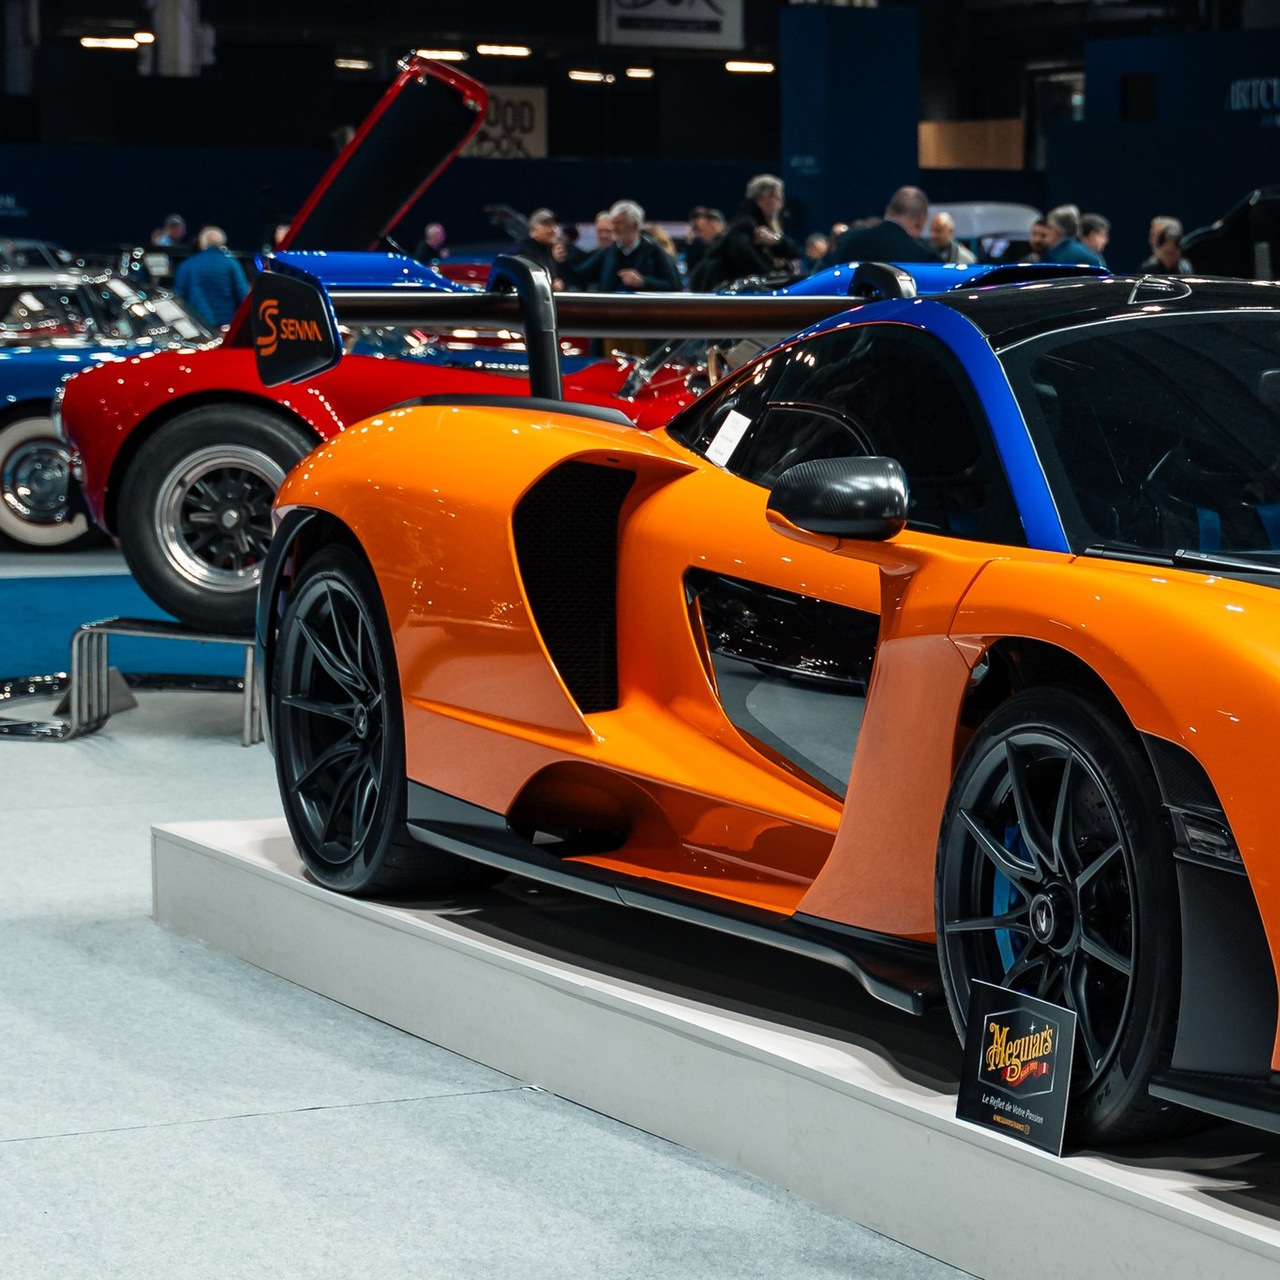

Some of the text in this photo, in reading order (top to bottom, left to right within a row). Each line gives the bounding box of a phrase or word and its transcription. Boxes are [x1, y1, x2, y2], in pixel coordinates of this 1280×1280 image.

[280, 319, 322, 341] SENNA
[986, 1022, 1053, 1082] Meguiar's
[982, 1093, 990, 1104] Le
[990, 1096, 1006, 1112] Reflet
[1005, 1101, 1012, 1113] de
[1026, 1109, 1043, 1124] Passion
